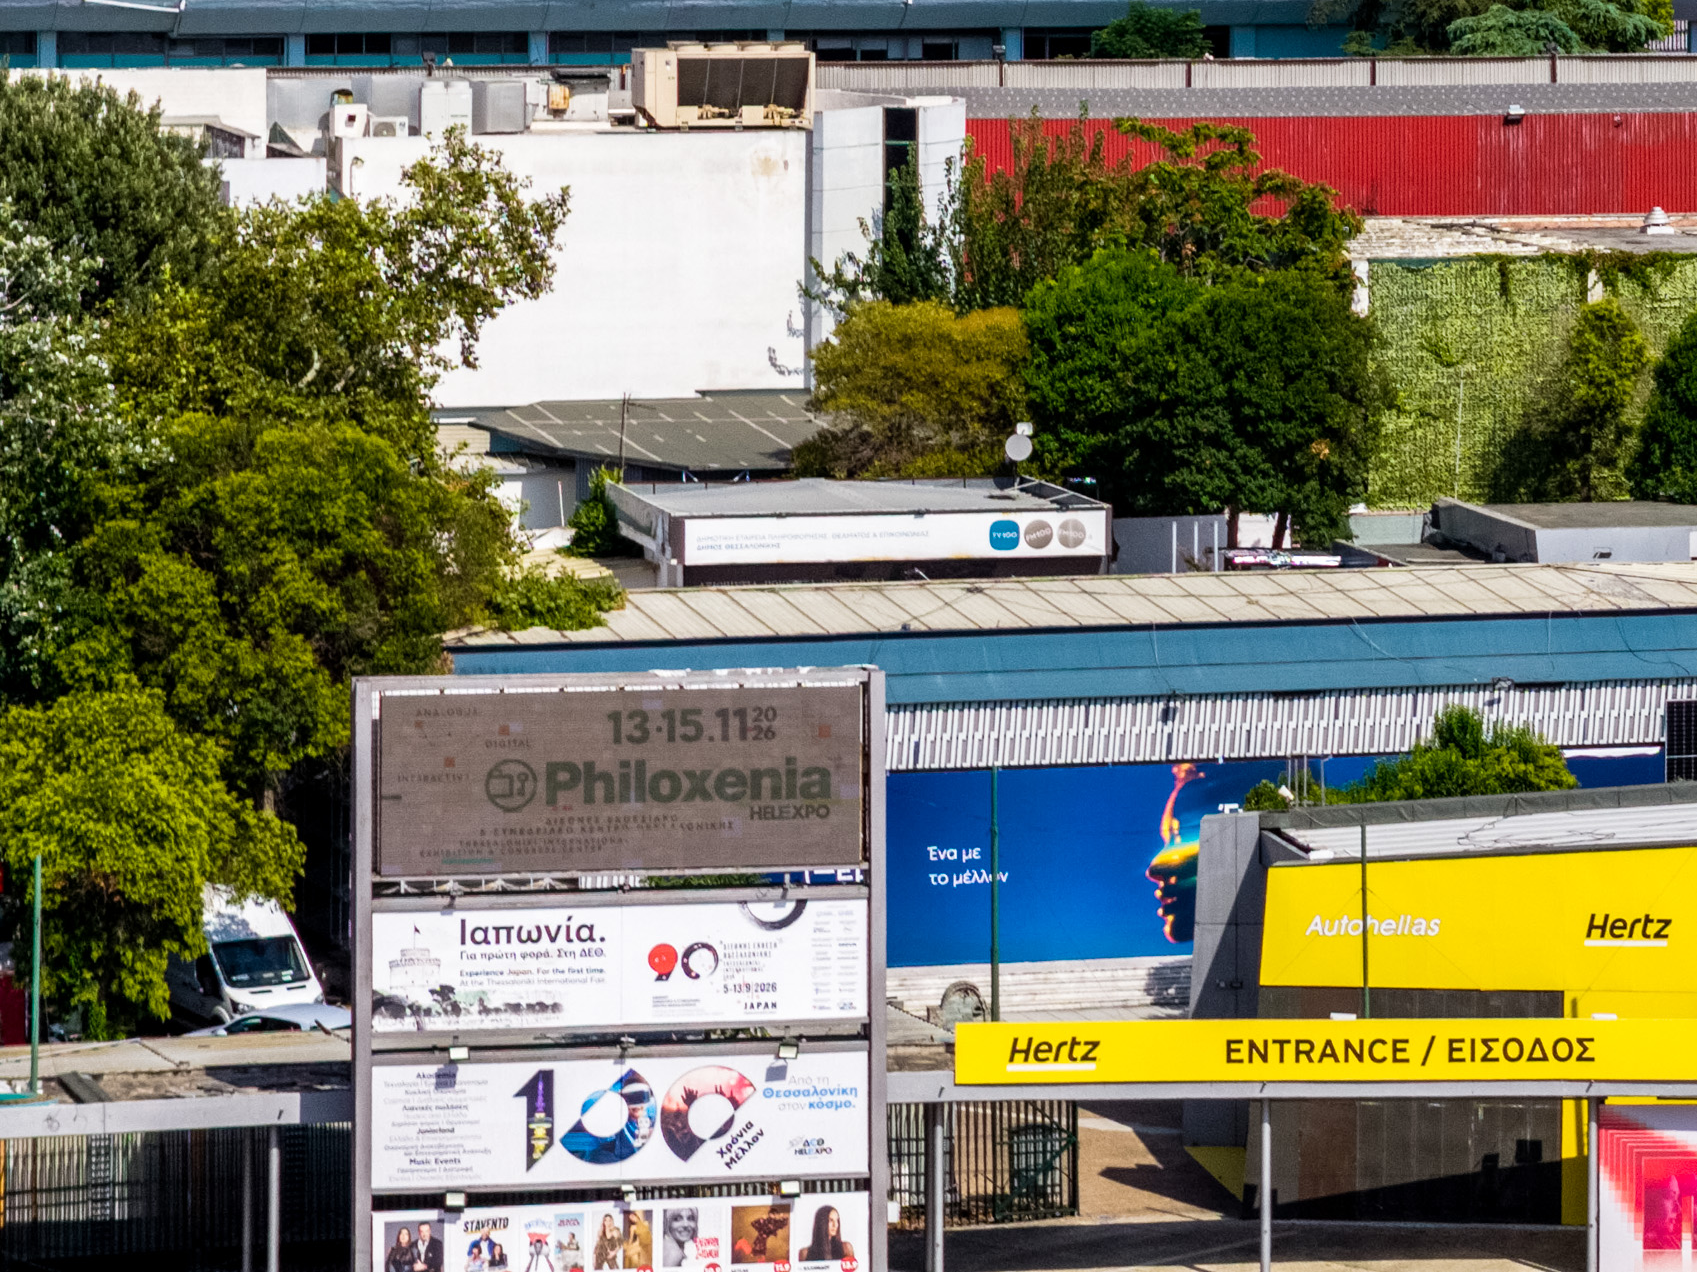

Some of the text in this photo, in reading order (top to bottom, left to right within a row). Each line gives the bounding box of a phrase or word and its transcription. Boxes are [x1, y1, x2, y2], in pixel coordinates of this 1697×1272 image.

[751, 706, 777, 723] 20
[751, 724, 777, 742] 26
[545, 756, 832, 806] Philoxenia
[750, 803, 830, 821] HELEXPO
[927, 845, 982, 863] Ένα με
[928, 872, 950, 886] το
[460, 915, 607, 946] Ιαπωνία.
[1305, 914, 1442, 937] Autohellas
[1584, 913, 1673, 940] Hertz
[460, 951, 477, 961] Για
[480, 950, 517, 962] πρώτη
[520, 949, 554, 962] φορά.
[557, 948, 576, 960] Στη
[648, 941, 720, 982] 90
[459, 968, 504, 978] Experience
[537, 968, 550, 976] For
[552, 967, 566, 975] the
[567, 967, 584, 975] first
[459, 978, 469, 987] At
[470, 977, 484, 986] the
[744, 1001, 778, 1010] JAPAN
[1009, 1036, 1101, 1063] Hertz
[1226, 1036, 1596, 1066] ENTRANCE / ΕΙΣΟΔΟΣ
[788, 1074, 830, 1087] Από τη
[762, 1086, 858, 1100] Θεσσαλονίκη
[778, 1097, 857, 1112] στον κόσμο.
[715, 1120, 754, 1160] Χρόνια
[724, 1128, 766, 1171] Μέλλον
[794, 1147, 833, 1156] HELEXPO
[409, 1157, 461, 1166] Music Events
[463, 1217, 509, 1233] STAVENTO
